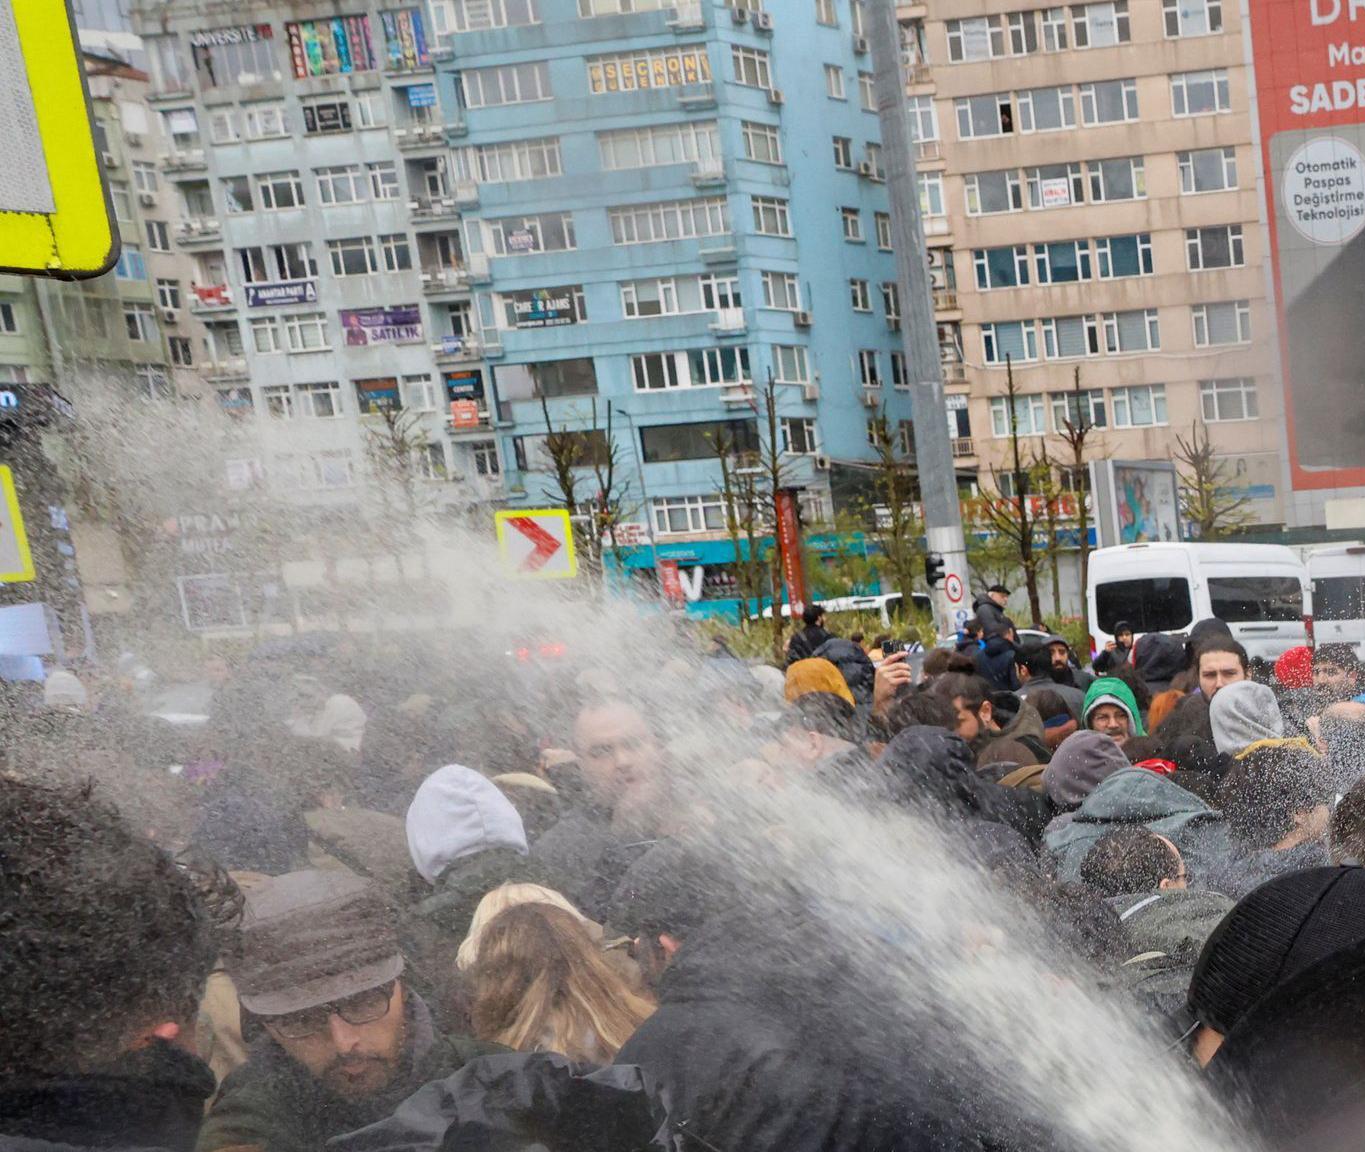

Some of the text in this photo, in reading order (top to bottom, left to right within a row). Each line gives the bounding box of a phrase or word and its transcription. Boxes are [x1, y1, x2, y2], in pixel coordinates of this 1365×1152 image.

[1295, 157, 1357, 174] Otomatik
[1304, 176, 1351, 190] Paspas
[1294, 190, 1364, 207] Değiştirme
[1296, 204, 1364, 221] Teknolojisi
[371, 325, 420, 342] SATILIK
